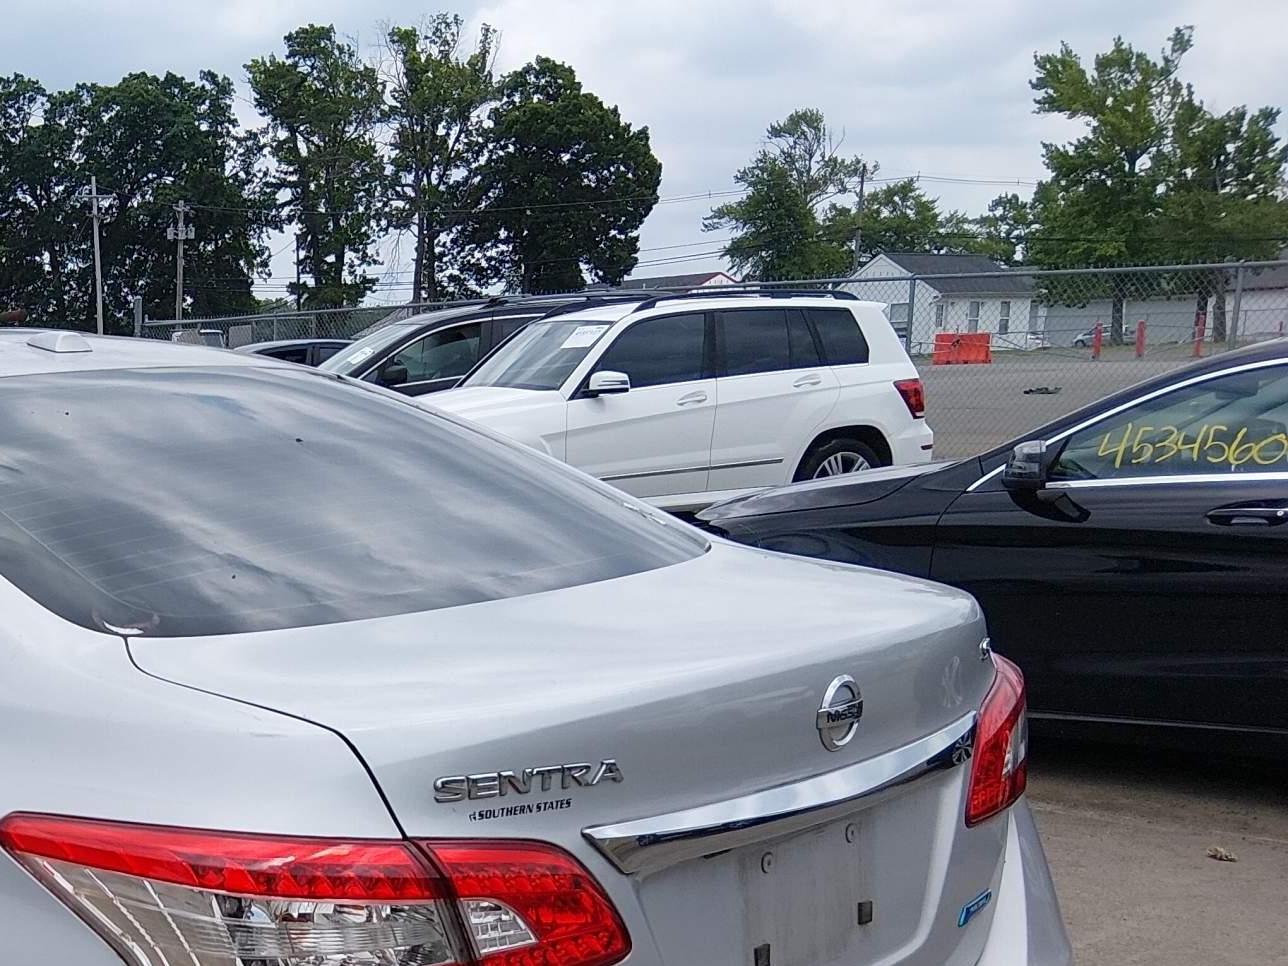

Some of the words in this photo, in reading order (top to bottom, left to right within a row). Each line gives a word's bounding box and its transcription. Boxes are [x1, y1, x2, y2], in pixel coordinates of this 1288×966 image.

[433, 758, 624, 804] SENTRA
[477, 804, 533, 821] SOUTHERN
[535, 798, 573, 813] STATES
